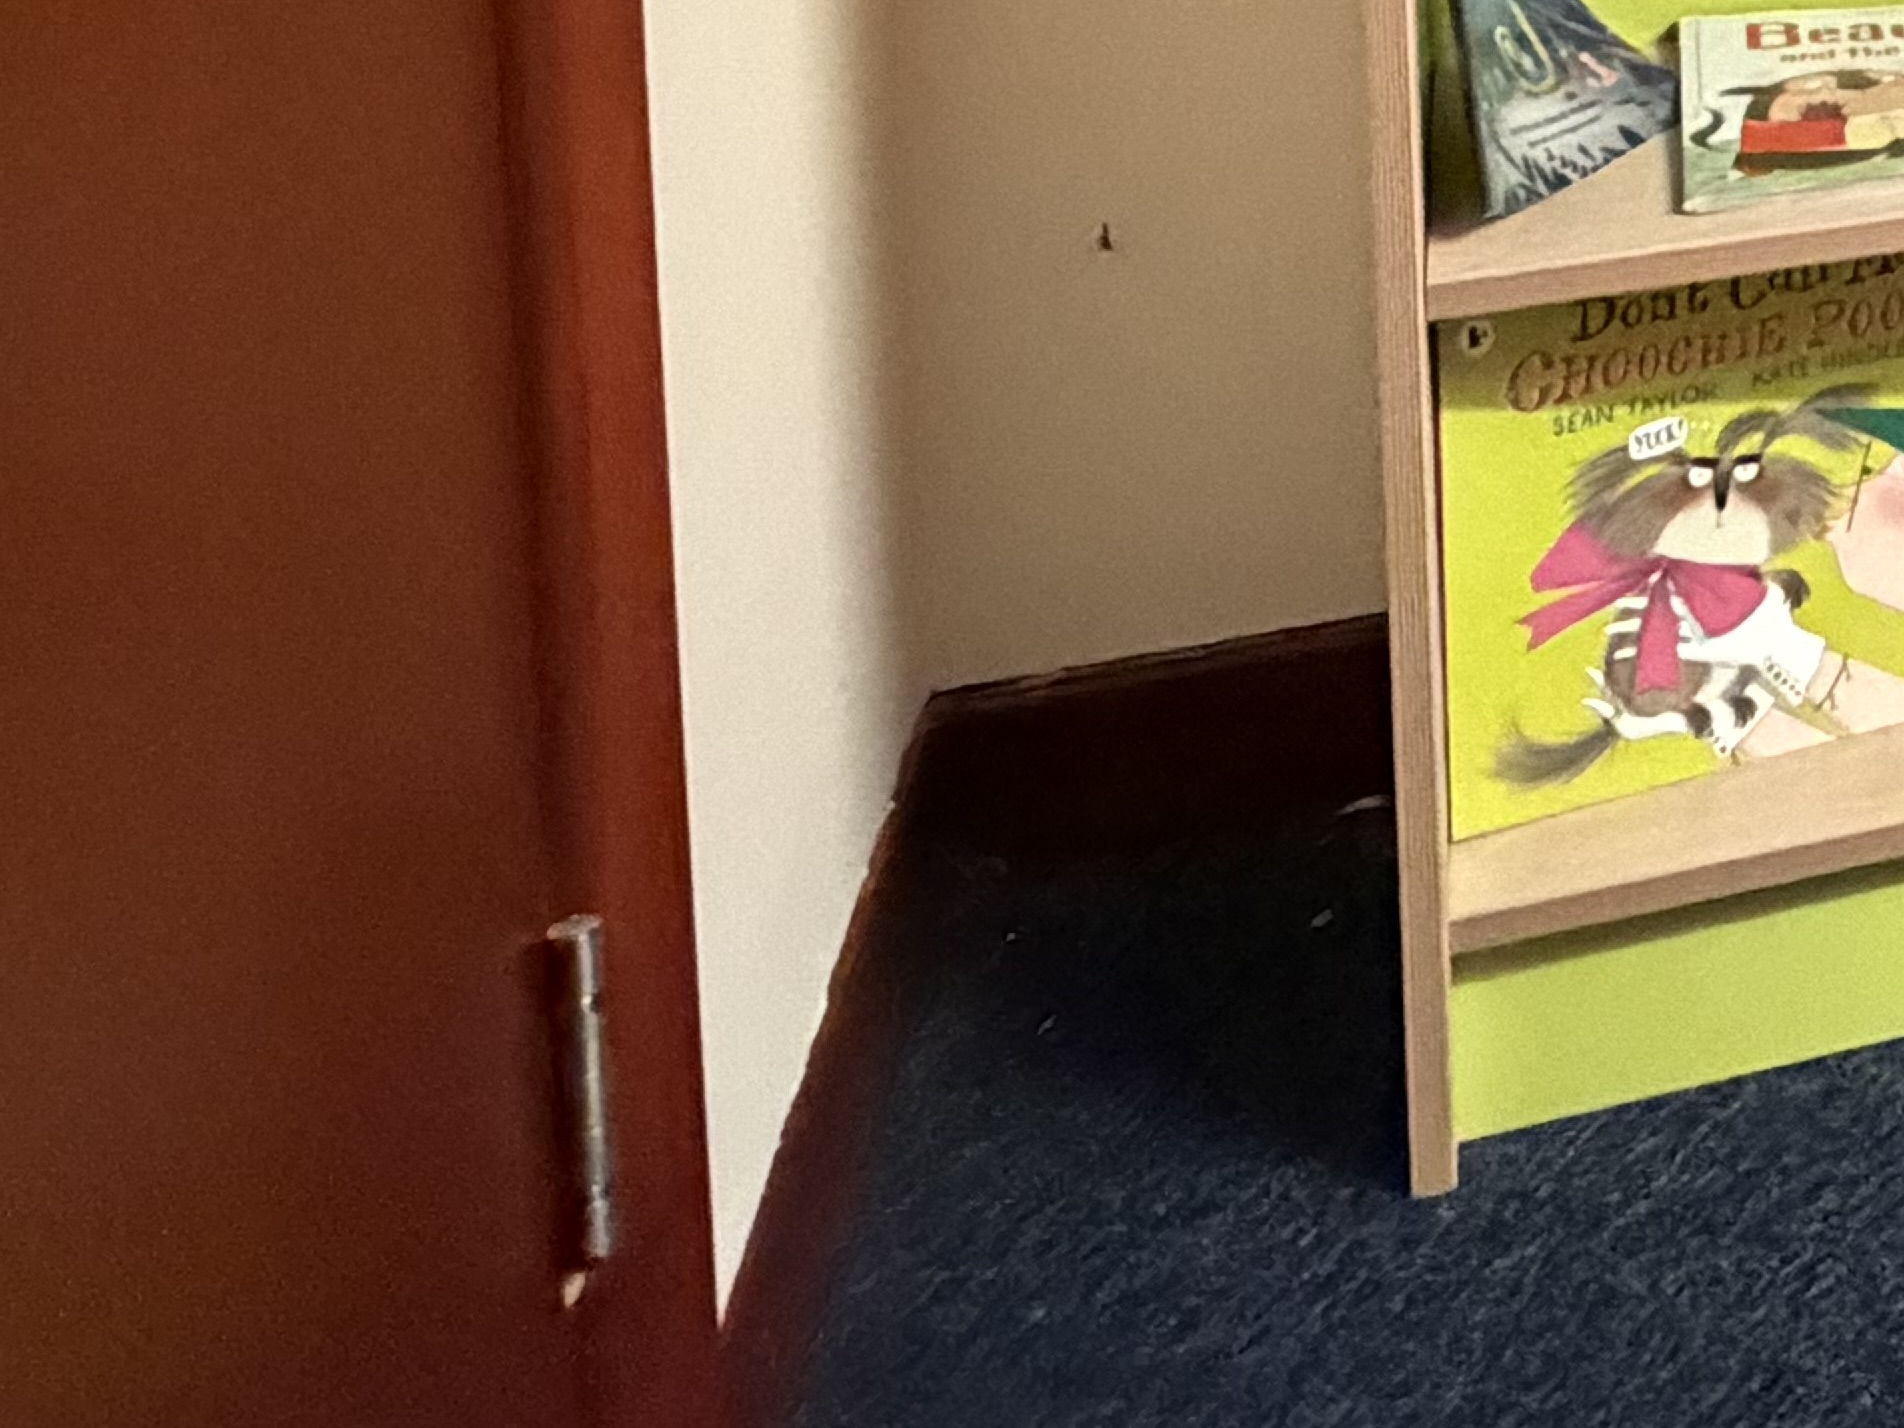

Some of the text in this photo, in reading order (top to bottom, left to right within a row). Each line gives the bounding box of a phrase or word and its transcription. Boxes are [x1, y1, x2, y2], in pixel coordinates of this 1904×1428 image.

[1505, 312, 1786, 412] CHOOCHIE
[1553, 381, 1718, 437] SEAN TAYLOR
